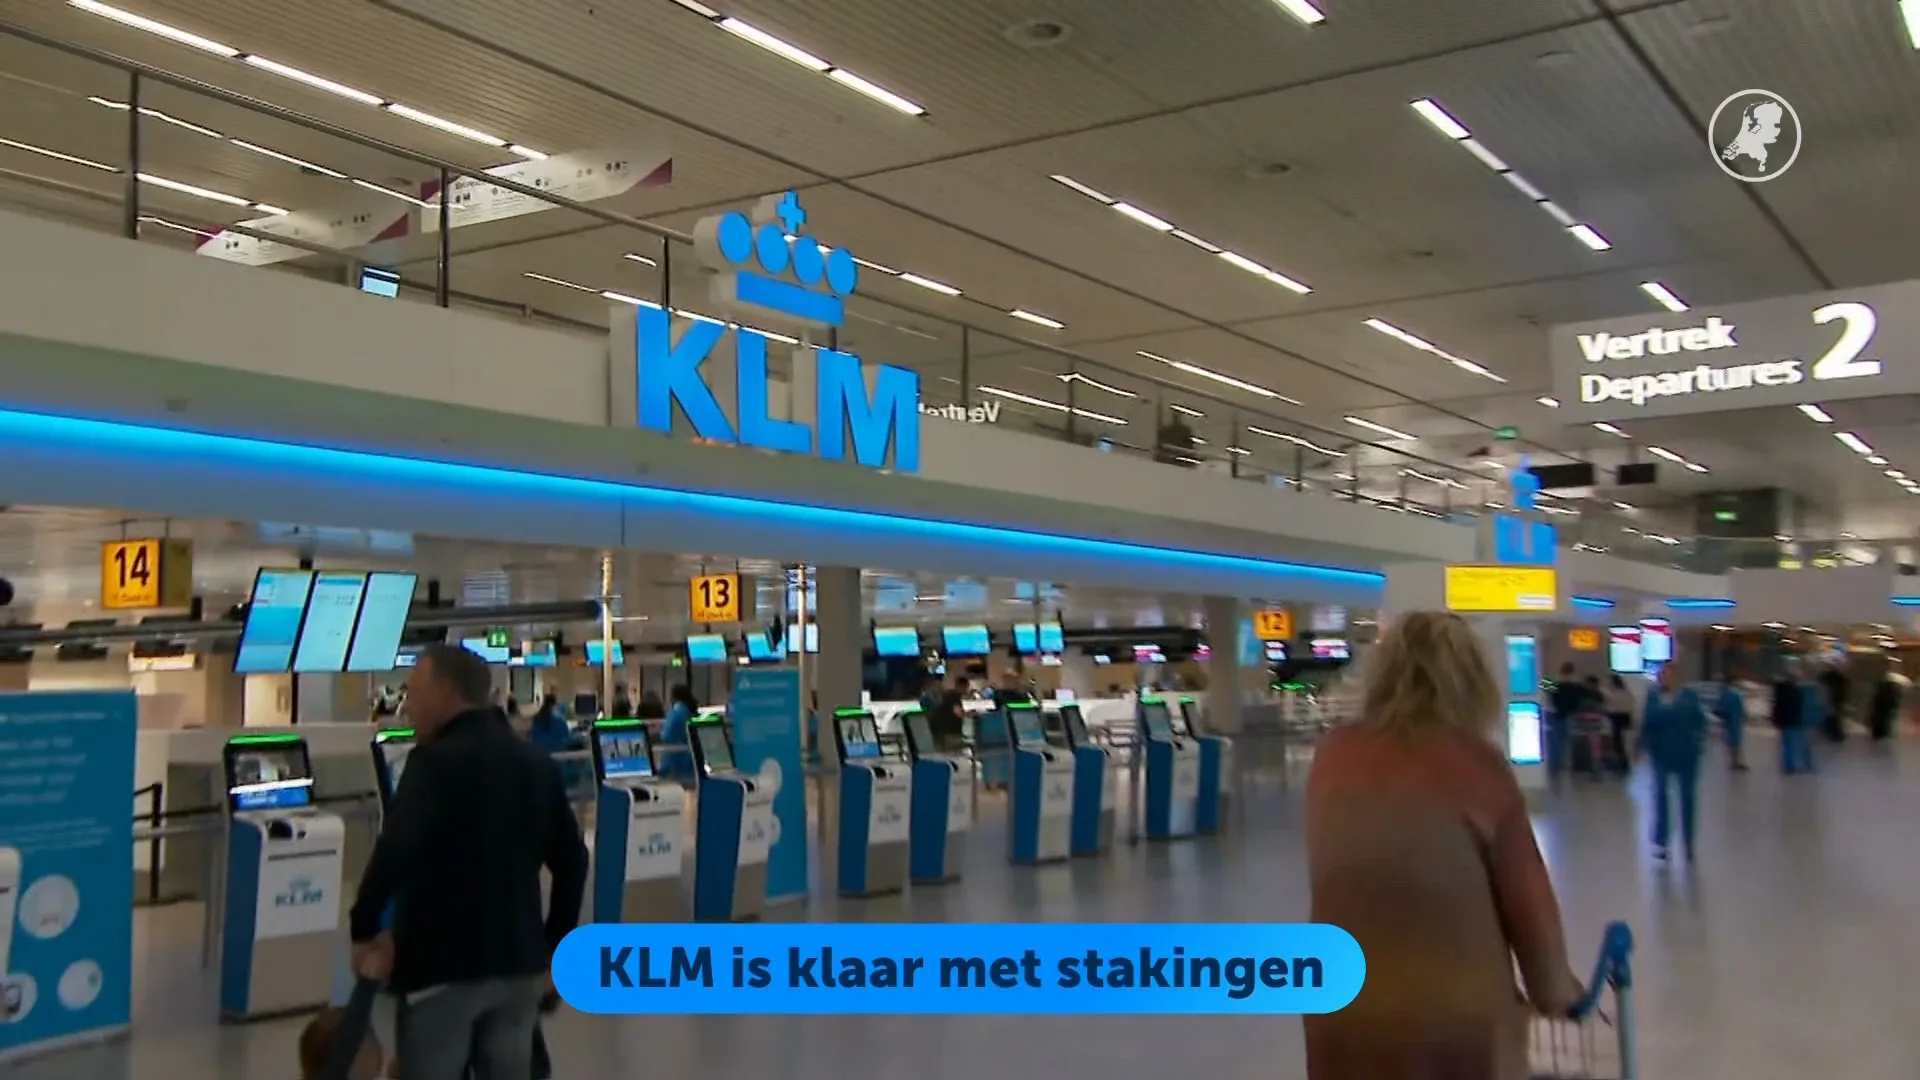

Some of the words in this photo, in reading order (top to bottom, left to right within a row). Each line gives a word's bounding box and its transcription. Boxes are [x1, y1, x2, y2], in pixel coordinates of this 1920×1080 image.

[1577, 316, 1738, 362] Vertrek
[1811, 301, 1881, 380] 2
[637, 306, 920, 472] KLM
[1580, 359, 1804, 406] Departures
[114, 545, 150, 588] 14
[699, 578, 730, 608] 13
[1261, 611, 1284, 631] 12
[275, 888, 323, 908] KLM
